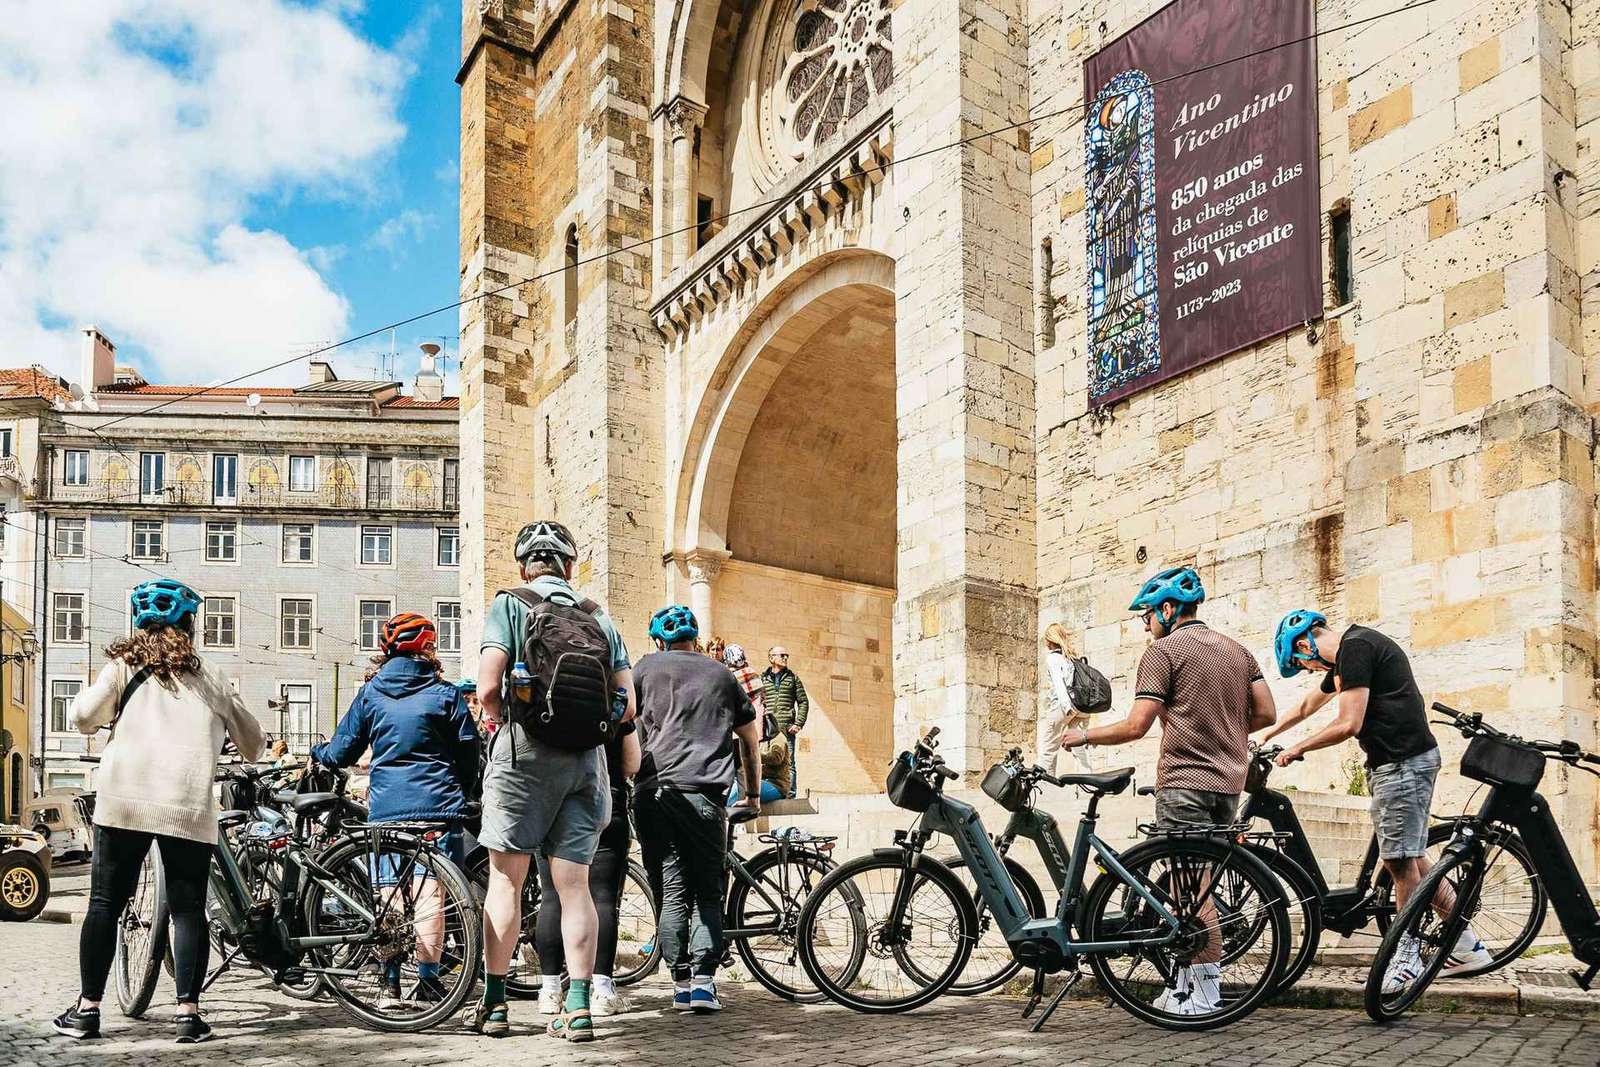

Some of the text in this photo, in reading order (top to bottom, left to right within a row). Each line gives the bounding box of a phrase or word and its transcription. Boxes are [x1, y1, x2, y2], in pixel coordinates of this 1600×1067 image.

[1169, 93, 1222, 133] Ano
[1173, 83, 1294, 160] Vicentino
[1171, 153, 1264, 211] 850 anos
[1171, 162, 1303, 236] da chegada das
[1172, 206, 1269, 263] relíquias de
[1173, 223, 1294, 289] São Vicente
[964, 828, 1002, 895] SCOTT
[1041, 830, 1069, 875] SCOT
